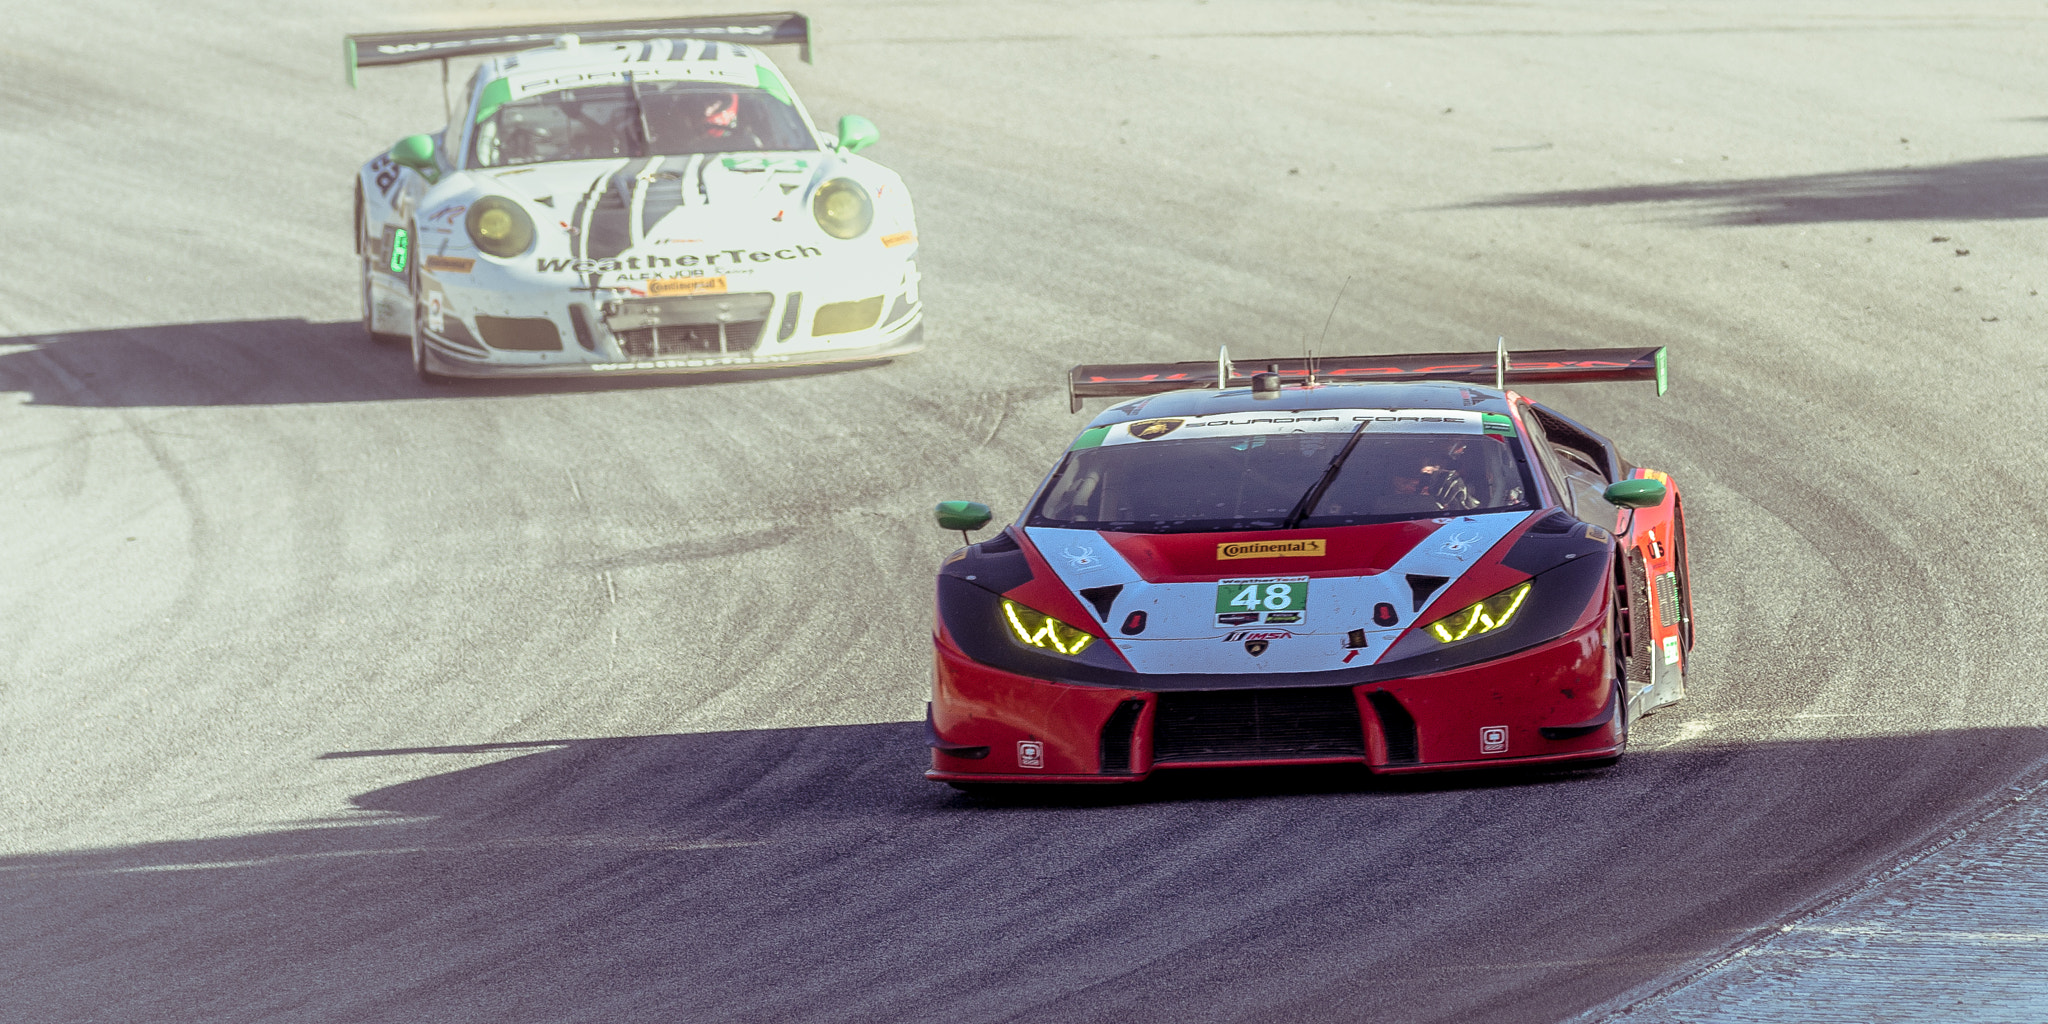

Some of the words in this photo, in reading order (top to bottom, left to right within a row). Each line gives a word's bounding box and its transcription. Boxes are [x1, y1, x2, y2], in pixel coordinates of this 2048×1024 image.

[537, 245, 822, 273] WeatherTech
[616, 269, 663, 281] ALEX
[649, 279, 715, 295] Continental
[1185, 416, 1340, 427] SQUADRA
[1352, 415, 1465, 424] CORSE
[1223, 541, 1306, 557] Continental
[1230, 583, 1292, 611] 48
[1246, 632, 1292, 640] IMSA
